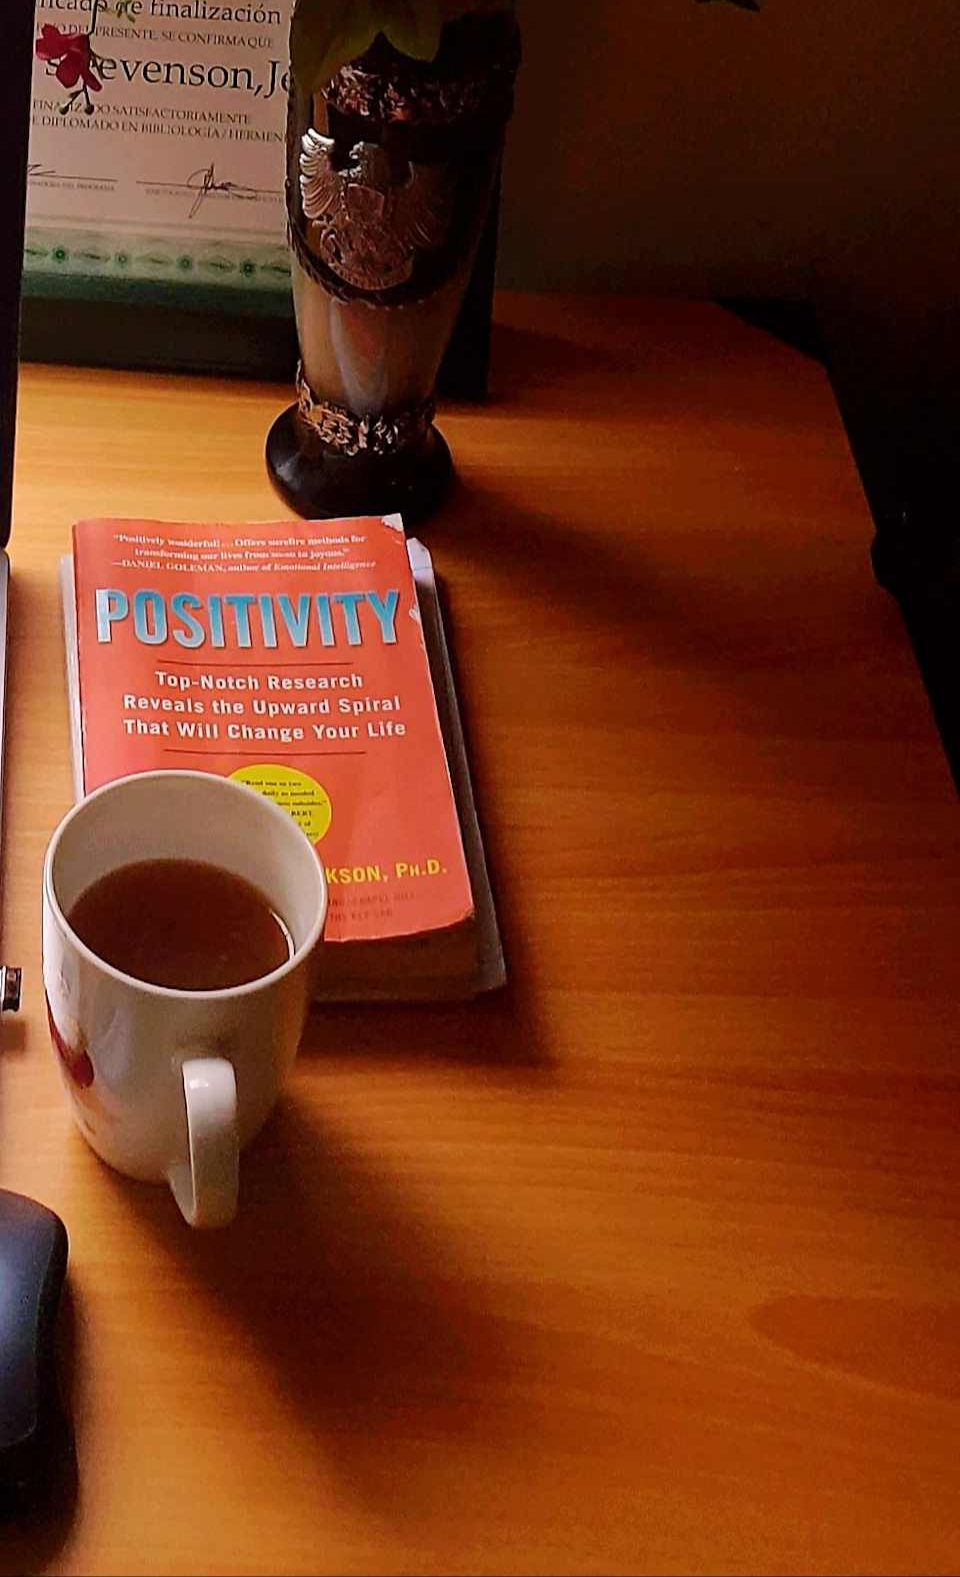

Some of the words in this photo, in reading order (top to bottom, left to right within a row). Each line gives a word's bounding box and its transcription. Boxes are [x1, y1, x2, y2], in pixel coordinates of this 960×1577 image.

[178, 32, 246, 47] CONFIRMA
[42, 115, 119, 131] DIPLOMADO
[307, 535, 350, 546] methods
[350, 533, 367, 543] for
[134, 548, 199, 561] transforming
[200, 552, 218, 560] our
[220, 550, 243, 560] lives
[244, 550, 269, 560] from
[297, 550, 309, 558] to
[227, 563, 260, 572] author
[261, 562, 273, 572] of
[273, 562, 321, 571] Emotional
[322, 560, 377, 571] Intelligence
[95, 588, 401, 649] POSITIVITY
[154, 670, 260, 692] Top-Notch
[267, 673, 364, 691] Research
[123, 693, 205, 714] Reveals
[211, 698, 245, 715] the
[252, 698, 331, 718] Upward
[338, 695, 401, 717] Spiral
[122, 718, 170, 736] That
[176, 721, 219, 739] Will
[227, 723, 305, 744] Change
[312, 723, 360, 740] Your
[367, 720, 406, 738] Life
